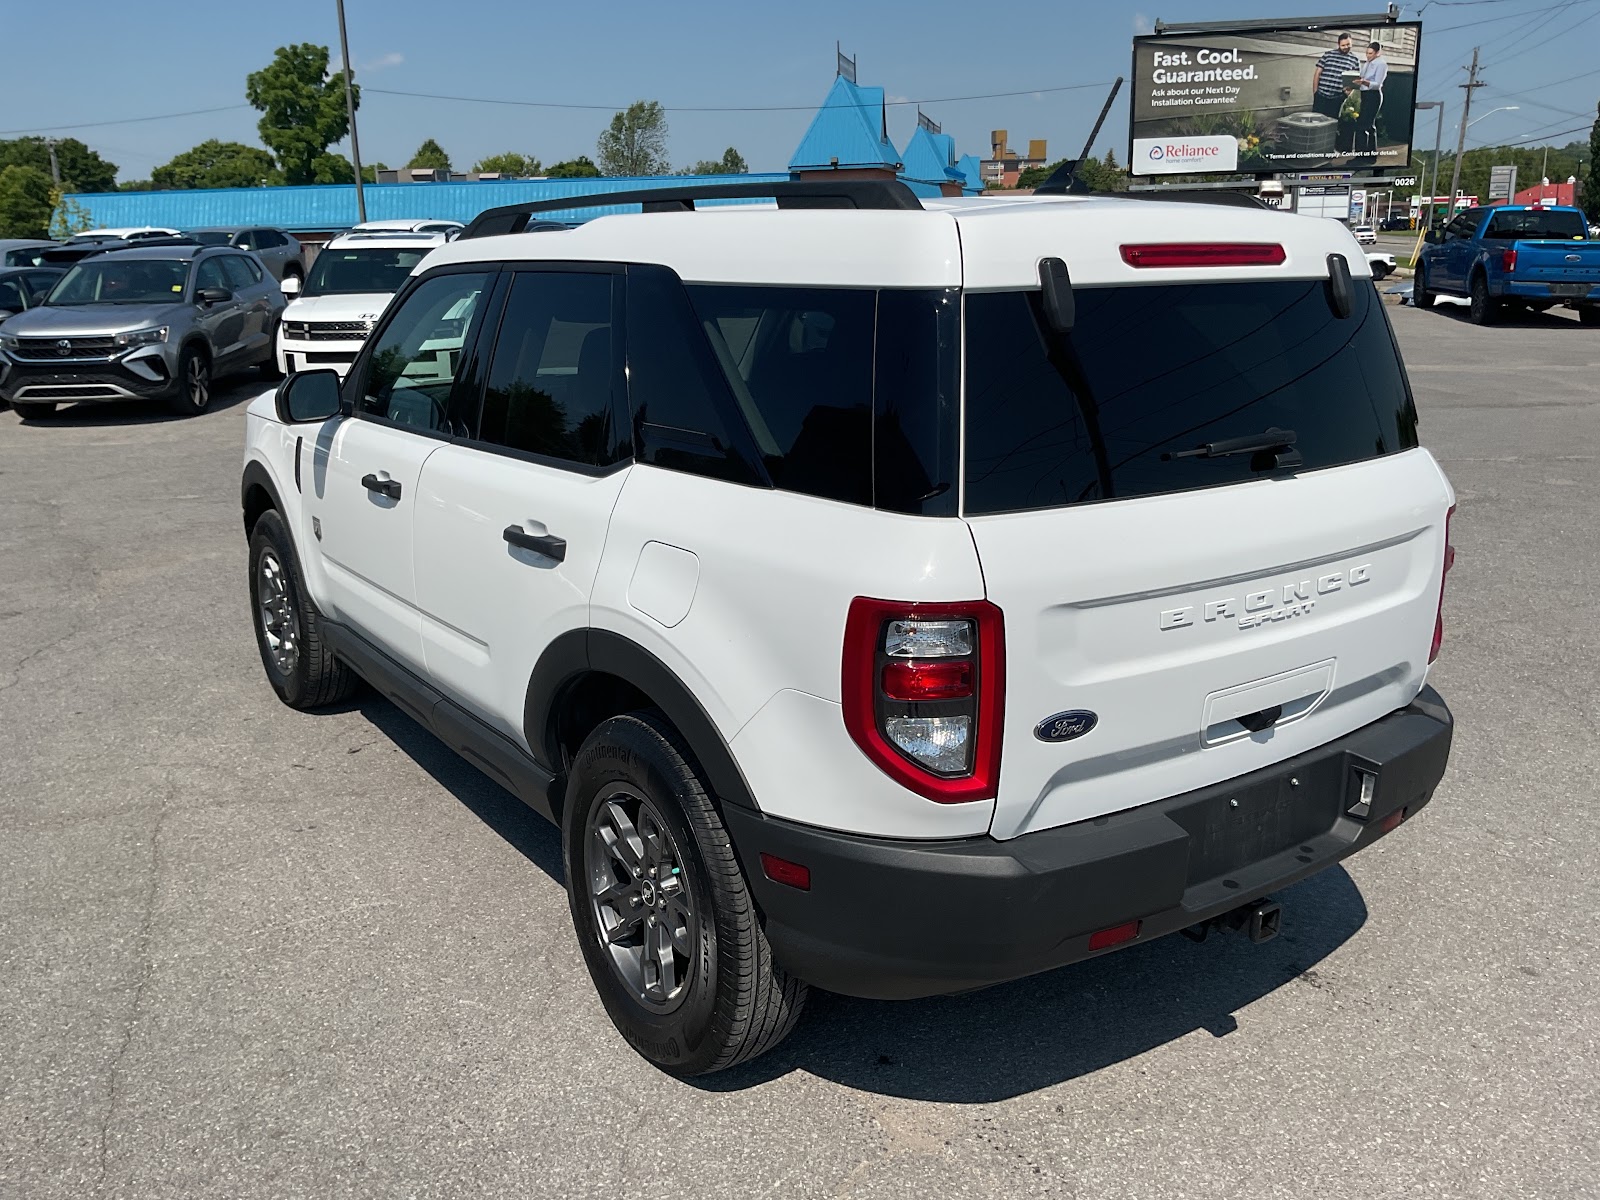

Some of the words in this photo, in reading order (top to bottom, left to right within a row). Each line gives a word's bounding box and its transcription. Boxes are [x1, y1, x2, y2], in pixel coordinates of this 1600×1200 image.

[1153, 51, 1192, 67] Fast.
[1196, 47, 1242, 65] Cool.
[1152, 64, 1259, 84] Guaranteed.
[1151, 89, 1165, 97] Ask
[1166, 88, 1189, 96] about
[1205, 86, 1224, 94] Next
[1225, 85, 1240, 95] Day
[1151, 98, 1194, 107] Installation
[1166, 144, 1219, 157] Reliance
[1394, 178, 1415, 186] 0026
[1160, 563, 1373, 632] BRONCO
[1238, 601, 1317, 630] SPORT
[1050, 717, 1086, 738] Ford
